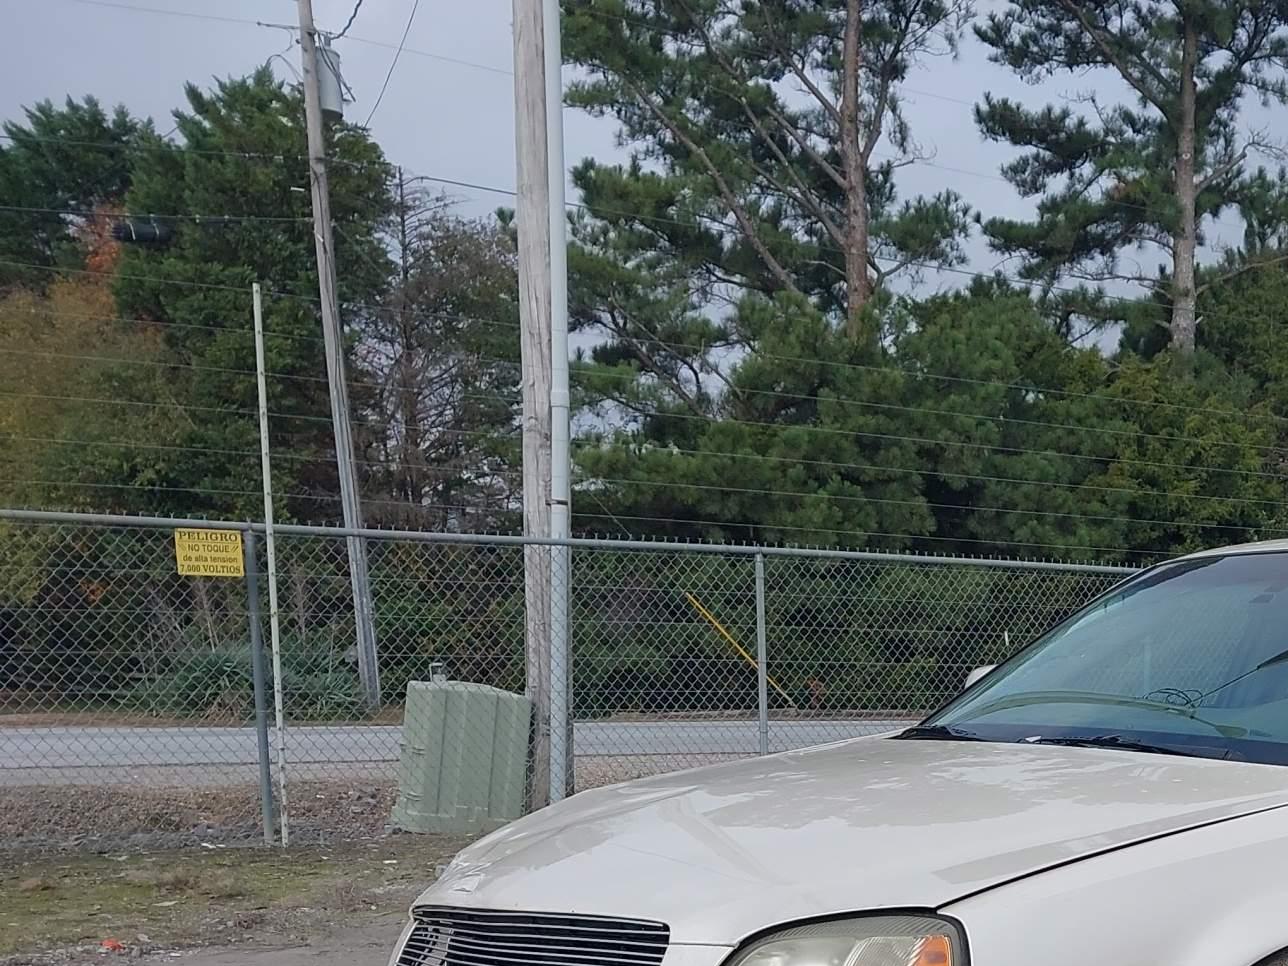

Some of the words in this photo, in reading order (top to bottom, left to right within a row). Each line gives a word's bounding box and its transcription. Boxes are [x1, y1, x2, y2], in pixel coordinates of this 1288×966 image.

[179, 531, 238, 542] PELIGRO
[188, 544, 200, 552] NO
[202, 544, 231, 553] TOQUE
[183, 554, 193, 562] de
[195, 554, 209, 563] alta
[202, 564, 241, 574] VOLTIOS
